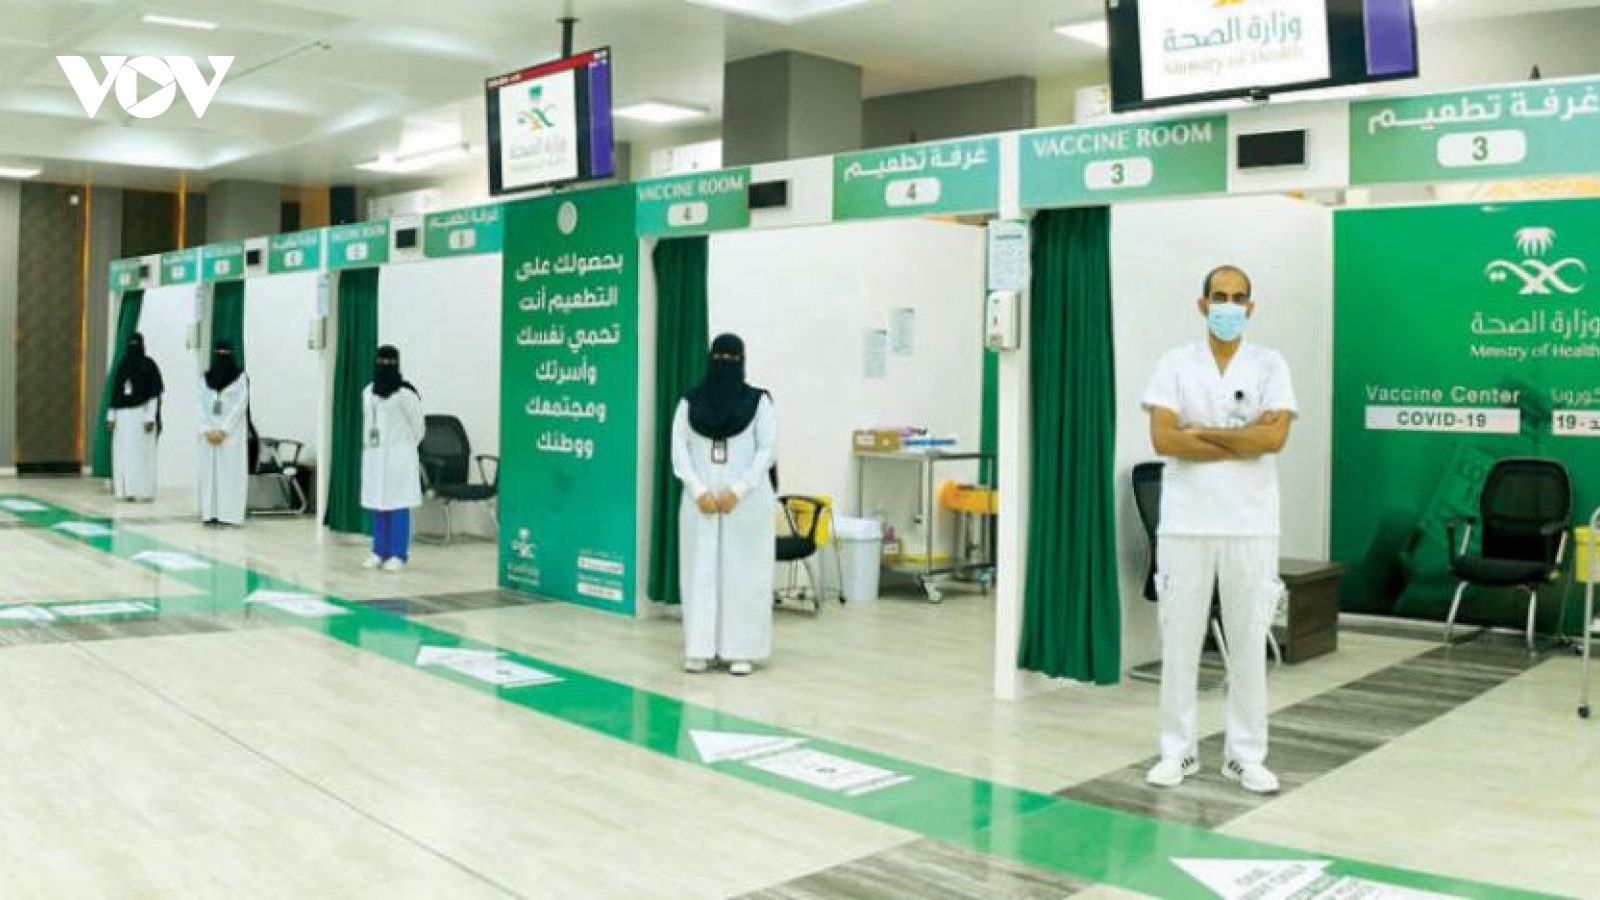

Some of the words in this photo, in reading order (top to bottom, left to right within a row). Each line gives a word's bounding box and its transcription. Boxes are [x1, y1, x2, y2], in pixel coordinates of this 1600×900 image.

[1162, 15, 1241, 51] الصحة
[1247, 10, 1302, 45] وزارة
[1367, 93, 1502, 135] تطعيم
[1510, 85, 1600, 121] غرفة
[929, 140, 989, 170] غرفة
[1031, 129, 1130, 159] VACCINE
[1136, 122, 1212, 150] ROOM
[1471, 135, 1489, 162] 3
[843, 148, 927, 184] تطعيم
[1110, 162, 1125, 185] 3
[698, 174, 743, 195] ROOM
[906, 182, 917, 200] 4
[682, 205, 692, 222] 4
[552, 251, 624, 278] بحصولك
[547, 285, 619, 315] التطعيم
[516, 324, 565, 346] نفسك
[1470, 307, 1546, 335] الصحة
[1550, 307, 1600, 340] وزارة
[566, 321, 621, 355] تحمي
[1469, 343, 1527, 362] Ministry
[1530, 341, 1552, 358] of
[1552, 342, 1600, 359] Health
[535, 355, 598, 386] وأسرتك
[1364, 384, 1444, 403] Vaccine
[1451, 386, 1522, 405] Center
[525, 395, 607, 424] ومجتمعك
[1396, 409, 1488, 429] COVID-19
[535, 431, 594, 461] ووطنك
